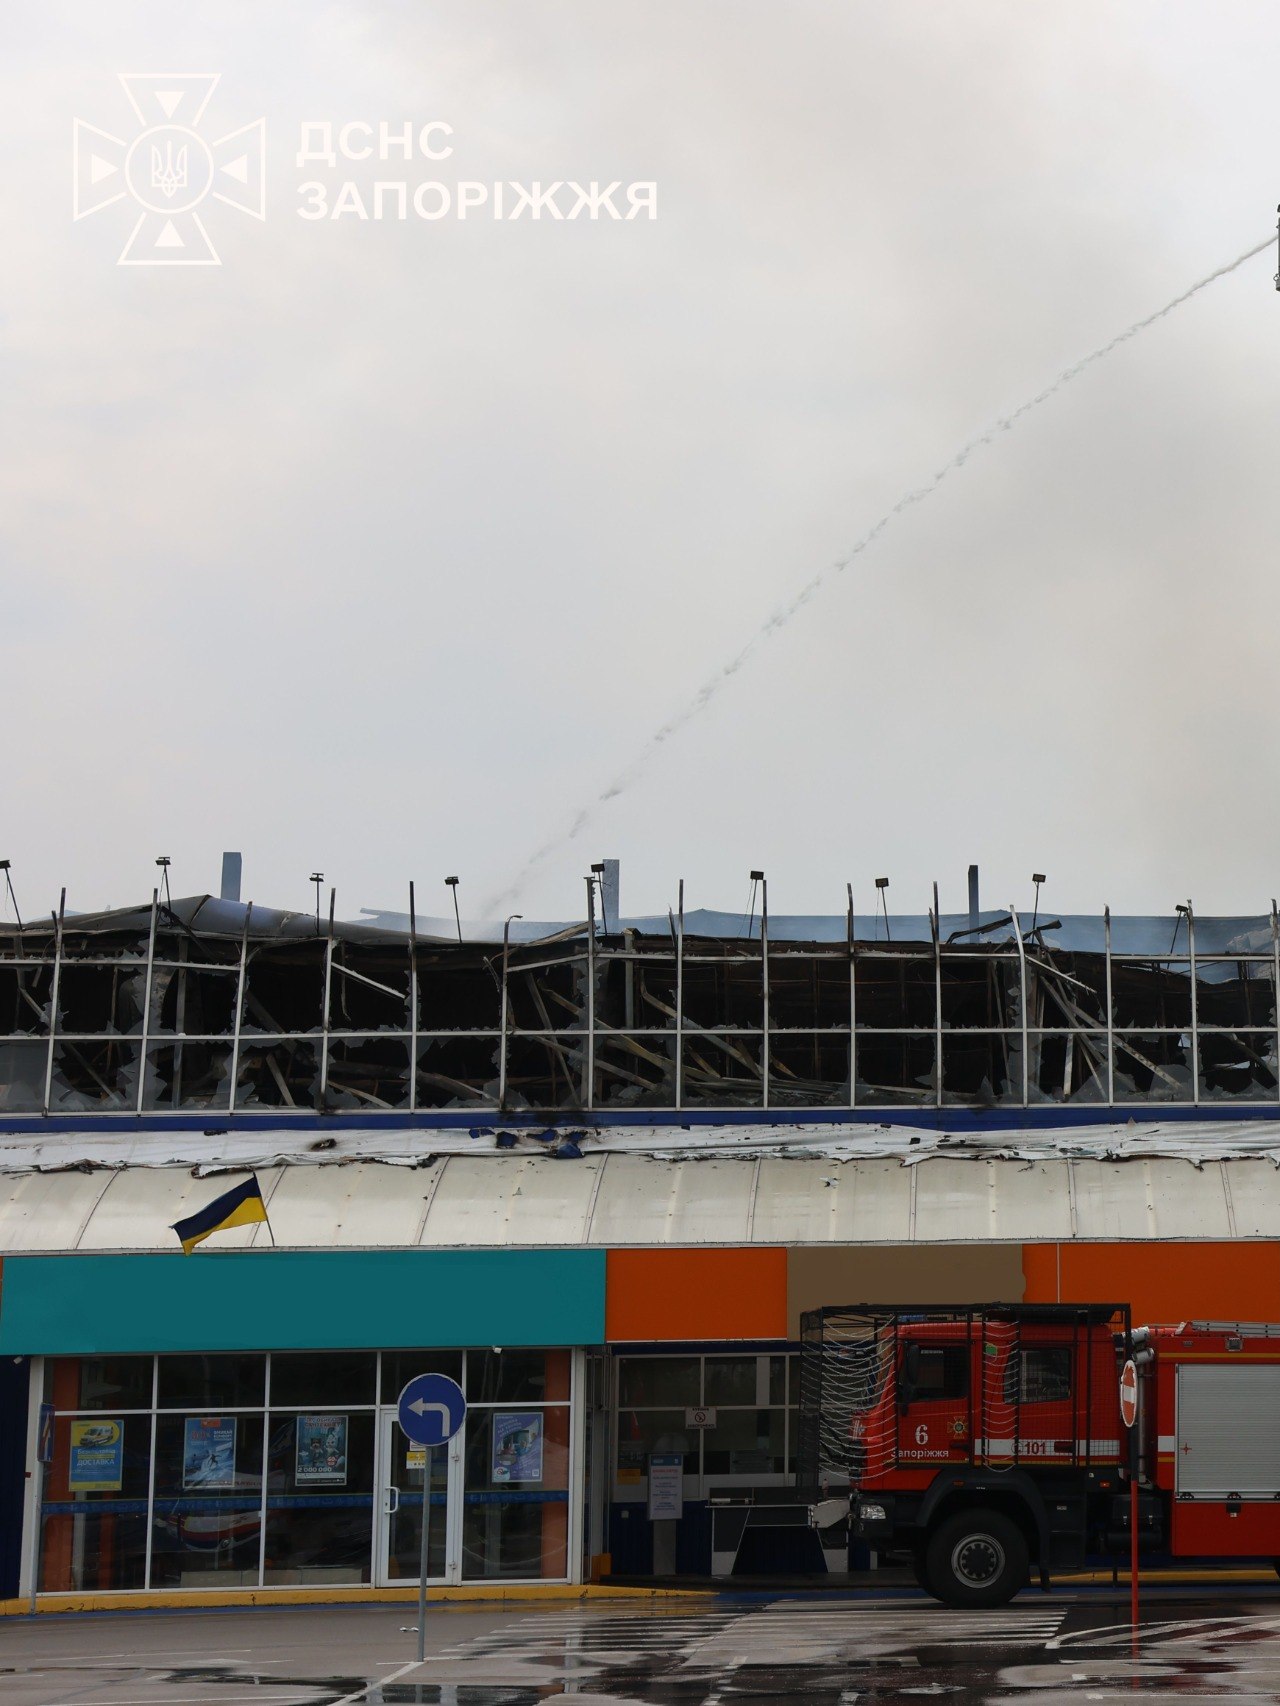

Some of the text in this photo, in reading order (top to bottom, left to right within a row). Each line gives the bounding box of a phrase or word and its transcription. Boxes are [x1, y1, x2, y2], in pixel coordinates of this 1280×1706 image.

[915, 1424, 929, 1445] 6
[890, 1448, 949, 1459] Запоріжжя
[1025, 1441, 1046, 1455] 101
[77, 1459, 115, 1467] ДОСТАВКА
